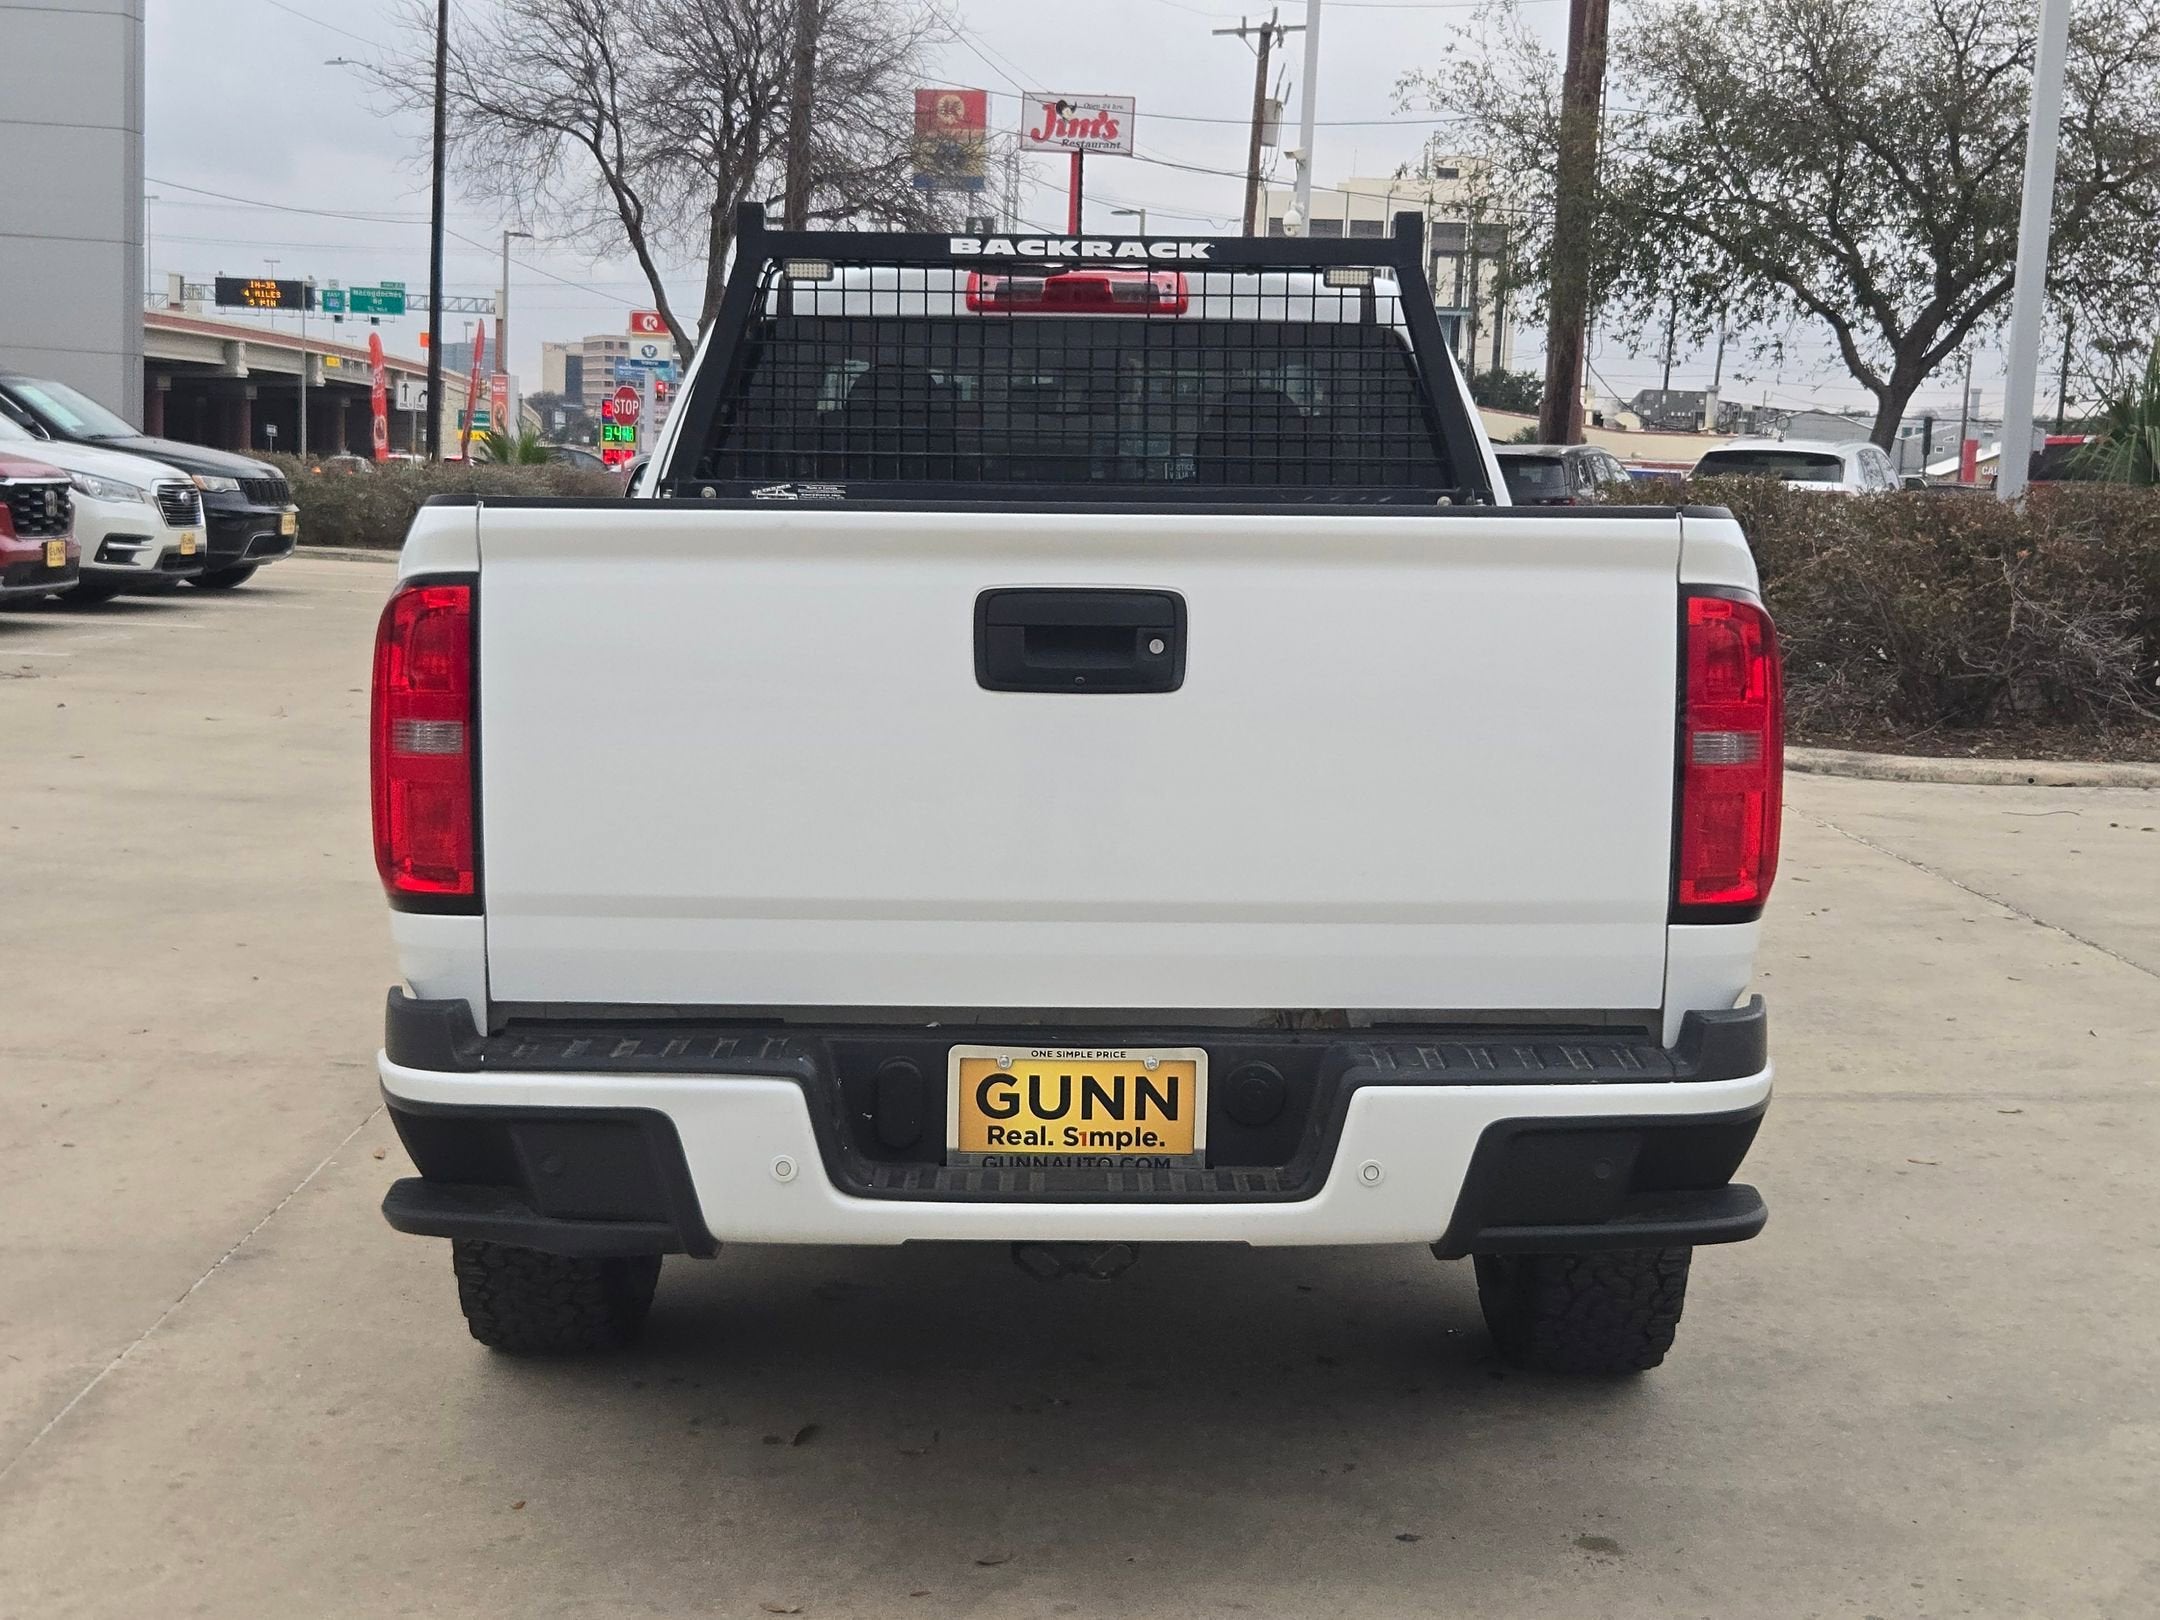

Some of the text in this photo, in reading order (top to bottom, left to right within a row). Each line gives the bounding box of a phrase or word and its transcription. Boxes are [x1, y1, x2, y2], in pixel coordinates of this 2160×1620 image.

[1031, 103, 1120, 143] Jim's
[1061, 138, 1121, 149] Restaurant
[950, 238, 1210, 259] BACKRACK
[244, 289, 281, 299] 4 MILES
[614, 400, 639, 415] STOP
[1031, 1050, 1127, 1059] ONE SIMPLE PRICE
[976, 1073, 1179, 1121] GUNN
[987, 1125, 1054, 1146] Real.
